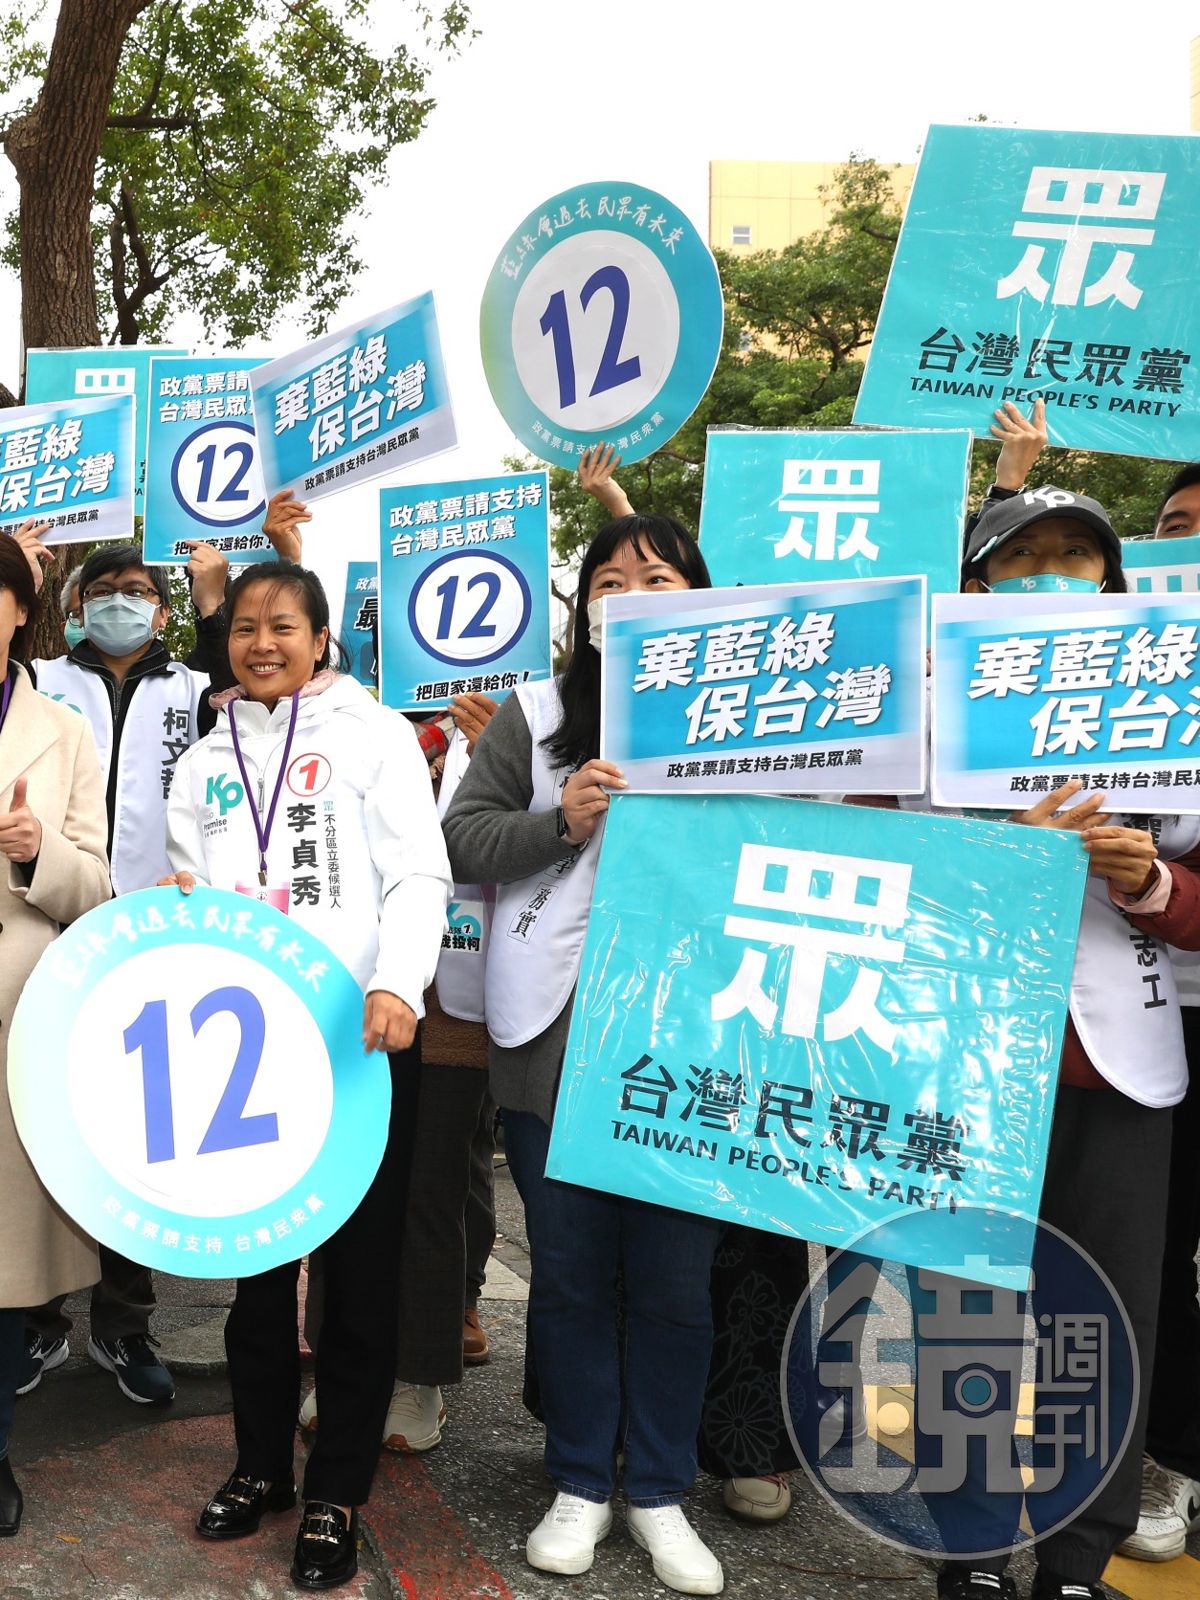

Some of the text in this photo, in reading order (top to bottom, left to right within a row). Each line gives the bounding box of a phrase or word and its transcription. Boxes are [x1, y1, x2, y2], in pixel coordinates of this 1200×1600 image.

[997, 166, 1168, 310] 眾
[539, 265, 642, 410] 12
[918, 326, 1192, 394] 台灣民眾黨
[159, 370, 250, 397] 政黨票請
[159, 395, 254, 423] 台灣民眾
[274, 333, 388, 437] 棄藍綠
[308, 359, 427, 463] 保台灣
[910, 376, 1182, 418] TAIWAN PEOPLE'S PARTY
[196, 442, 254, 503] 12
[304, 426, 420, 491] 政黨票請支持台灣民眾黨
[389, 482, 542, 528] 政黨票請支持
[390, 515, 517, 557] 台灣民眾黨
[773, 459, 880, 561] 眾
[436, 571, 502, 641] 12
[415, 671, 530, 701] 把國家還給你!
[631, 611, 835, 693] 棄藍綠
[967, 623, 1200, 700] 棄藍綠
[685, 663, 891, 746] 保台灣
[299, 760, 320, 790] 1
[667, 749, 863, 779] 政黨票請支持台灣民眾黨
[1010, 769, 1200, 792] 政黨票請支持台灣民
[287, 803, 321, 906] 李貞秀
[323, 814, 342, 909] 不分區立委候選人
[711, 842, 913, 1058] 眾
[123, 985, 279, 1164] 12
[619, 1053, 968, 1181] 台灣民眾黨
[611, 1120, 966, 1215] TAIWAN PEOPLE'S PARTY
